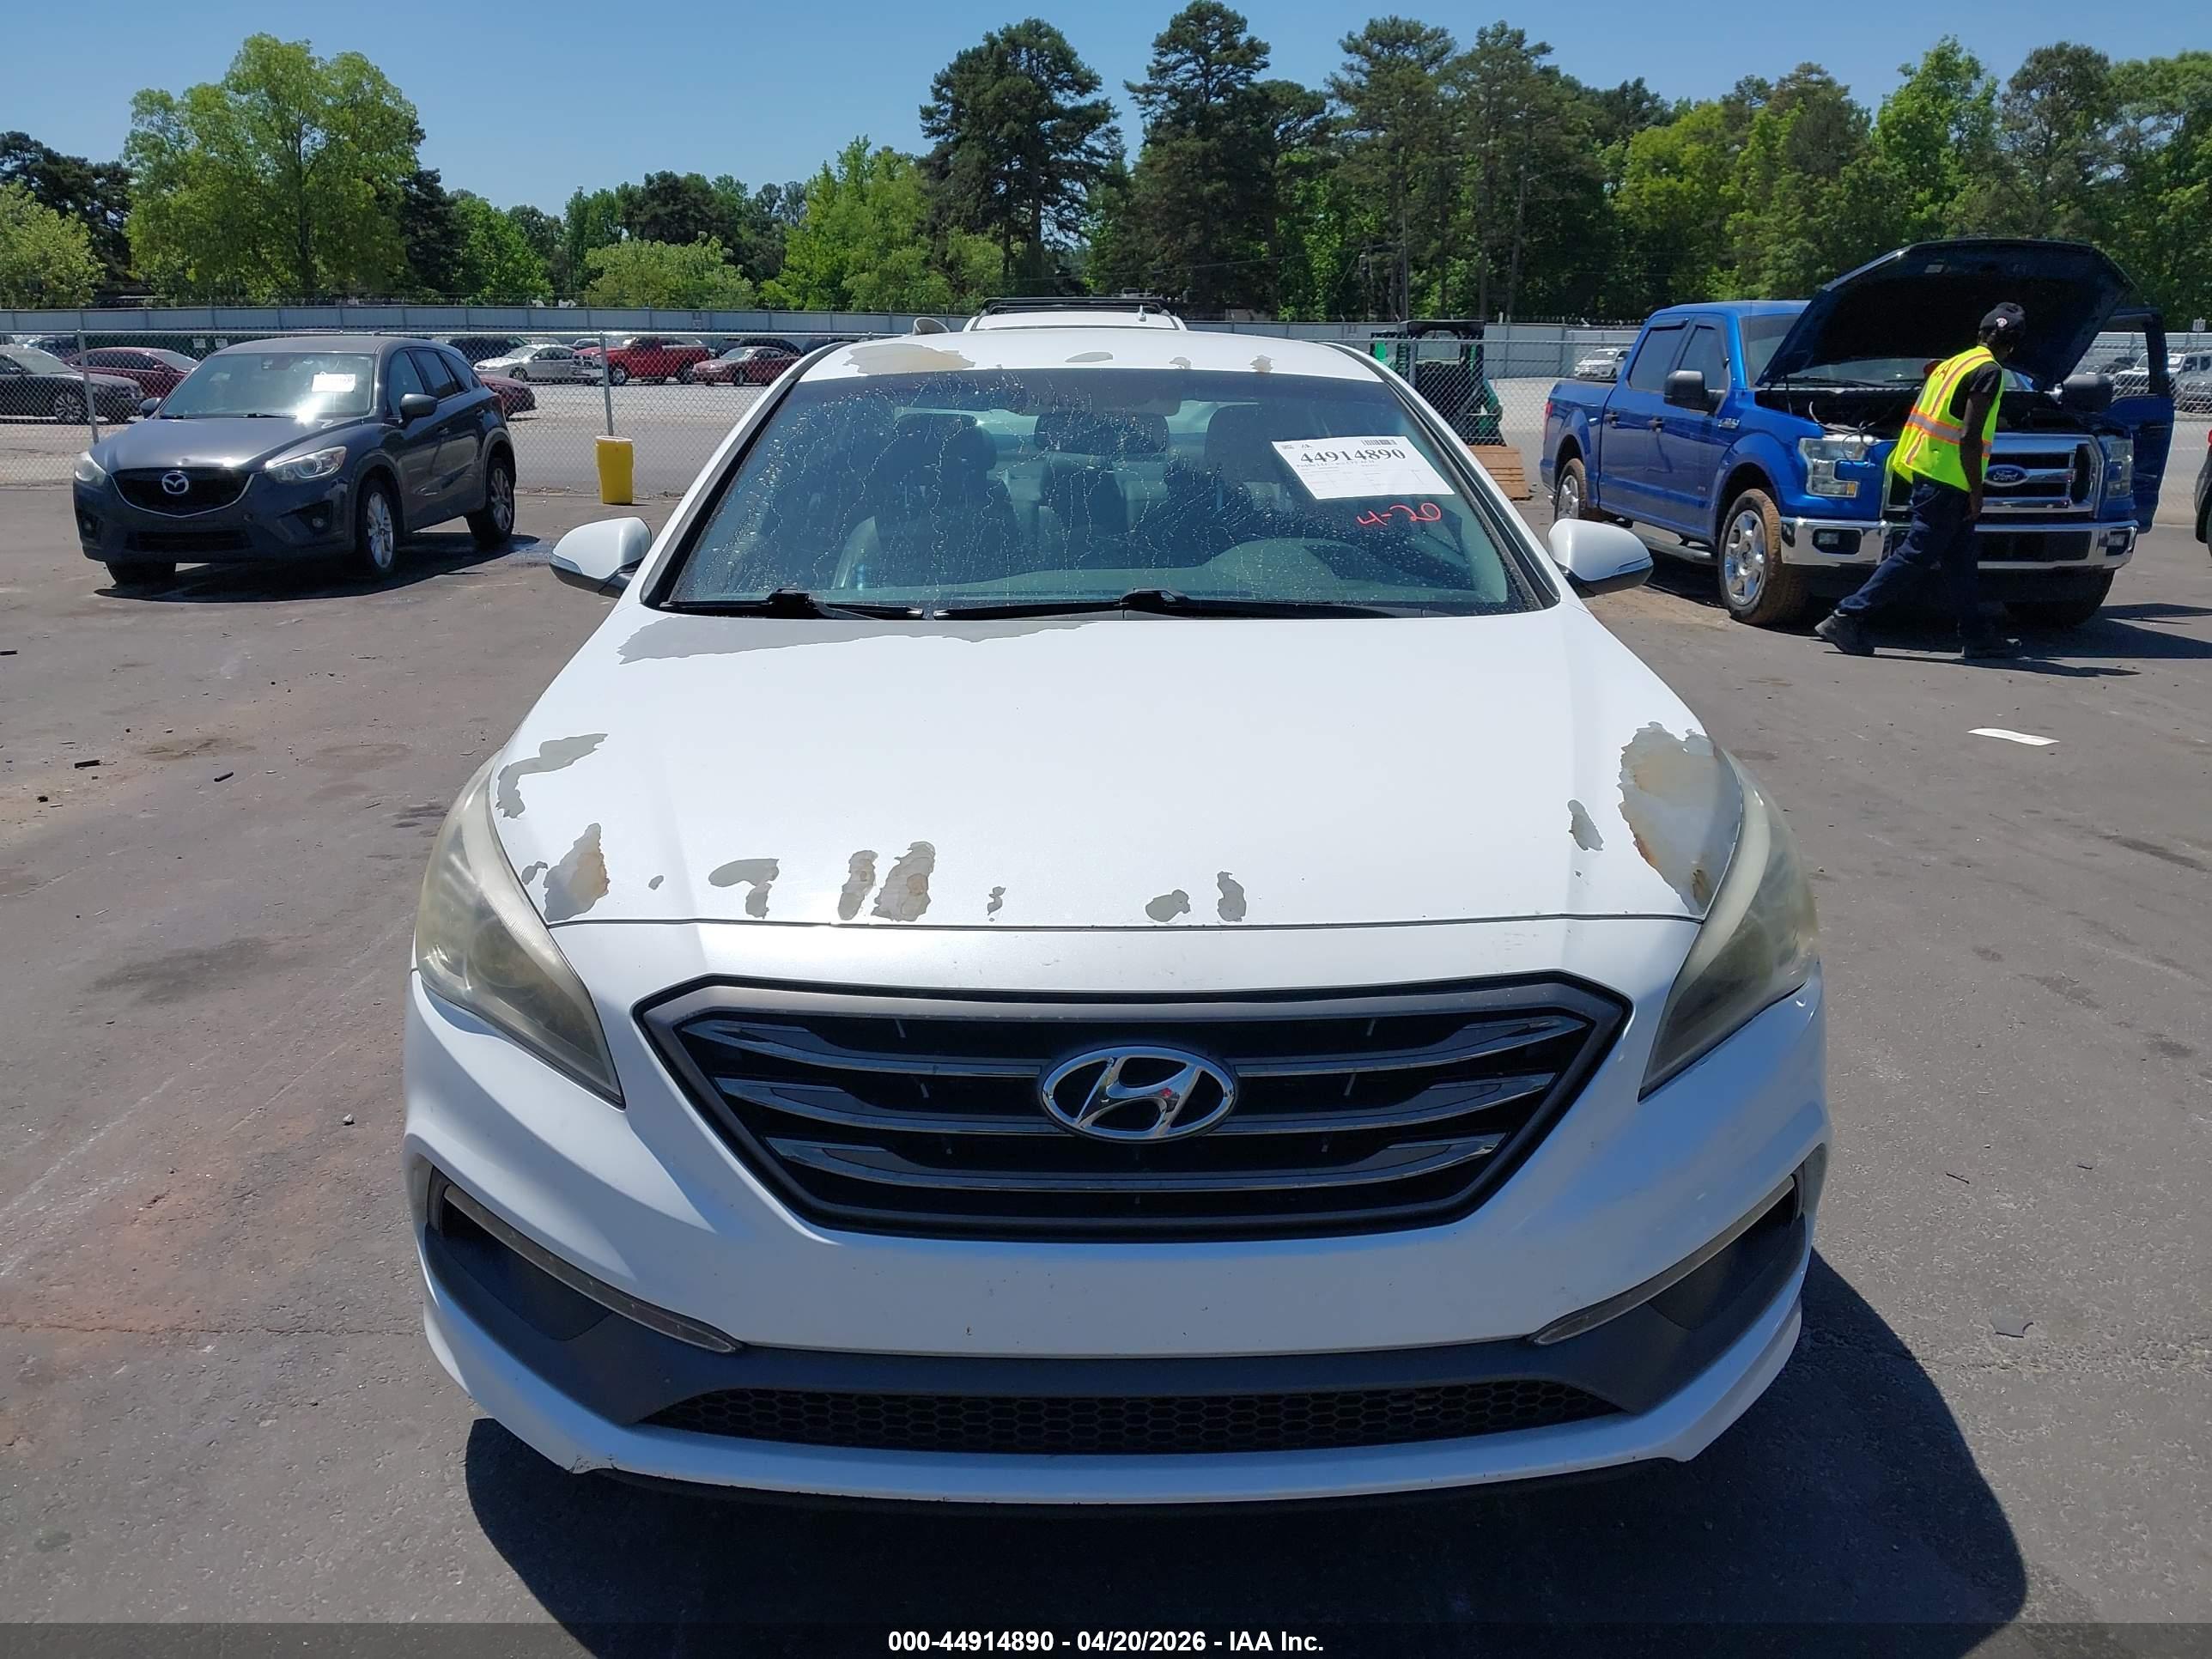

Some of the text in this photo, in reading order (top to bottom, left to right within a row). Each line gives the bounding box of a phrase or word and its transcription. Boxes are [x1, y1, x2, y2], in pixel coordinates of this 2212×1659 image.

[2195, 321, 2204, 330] 10
[1300, 448, 1407, 464] 44914890
[1992, 470, 2018, 481] Ford
[1357, 502, 1442, 526] 4-20
